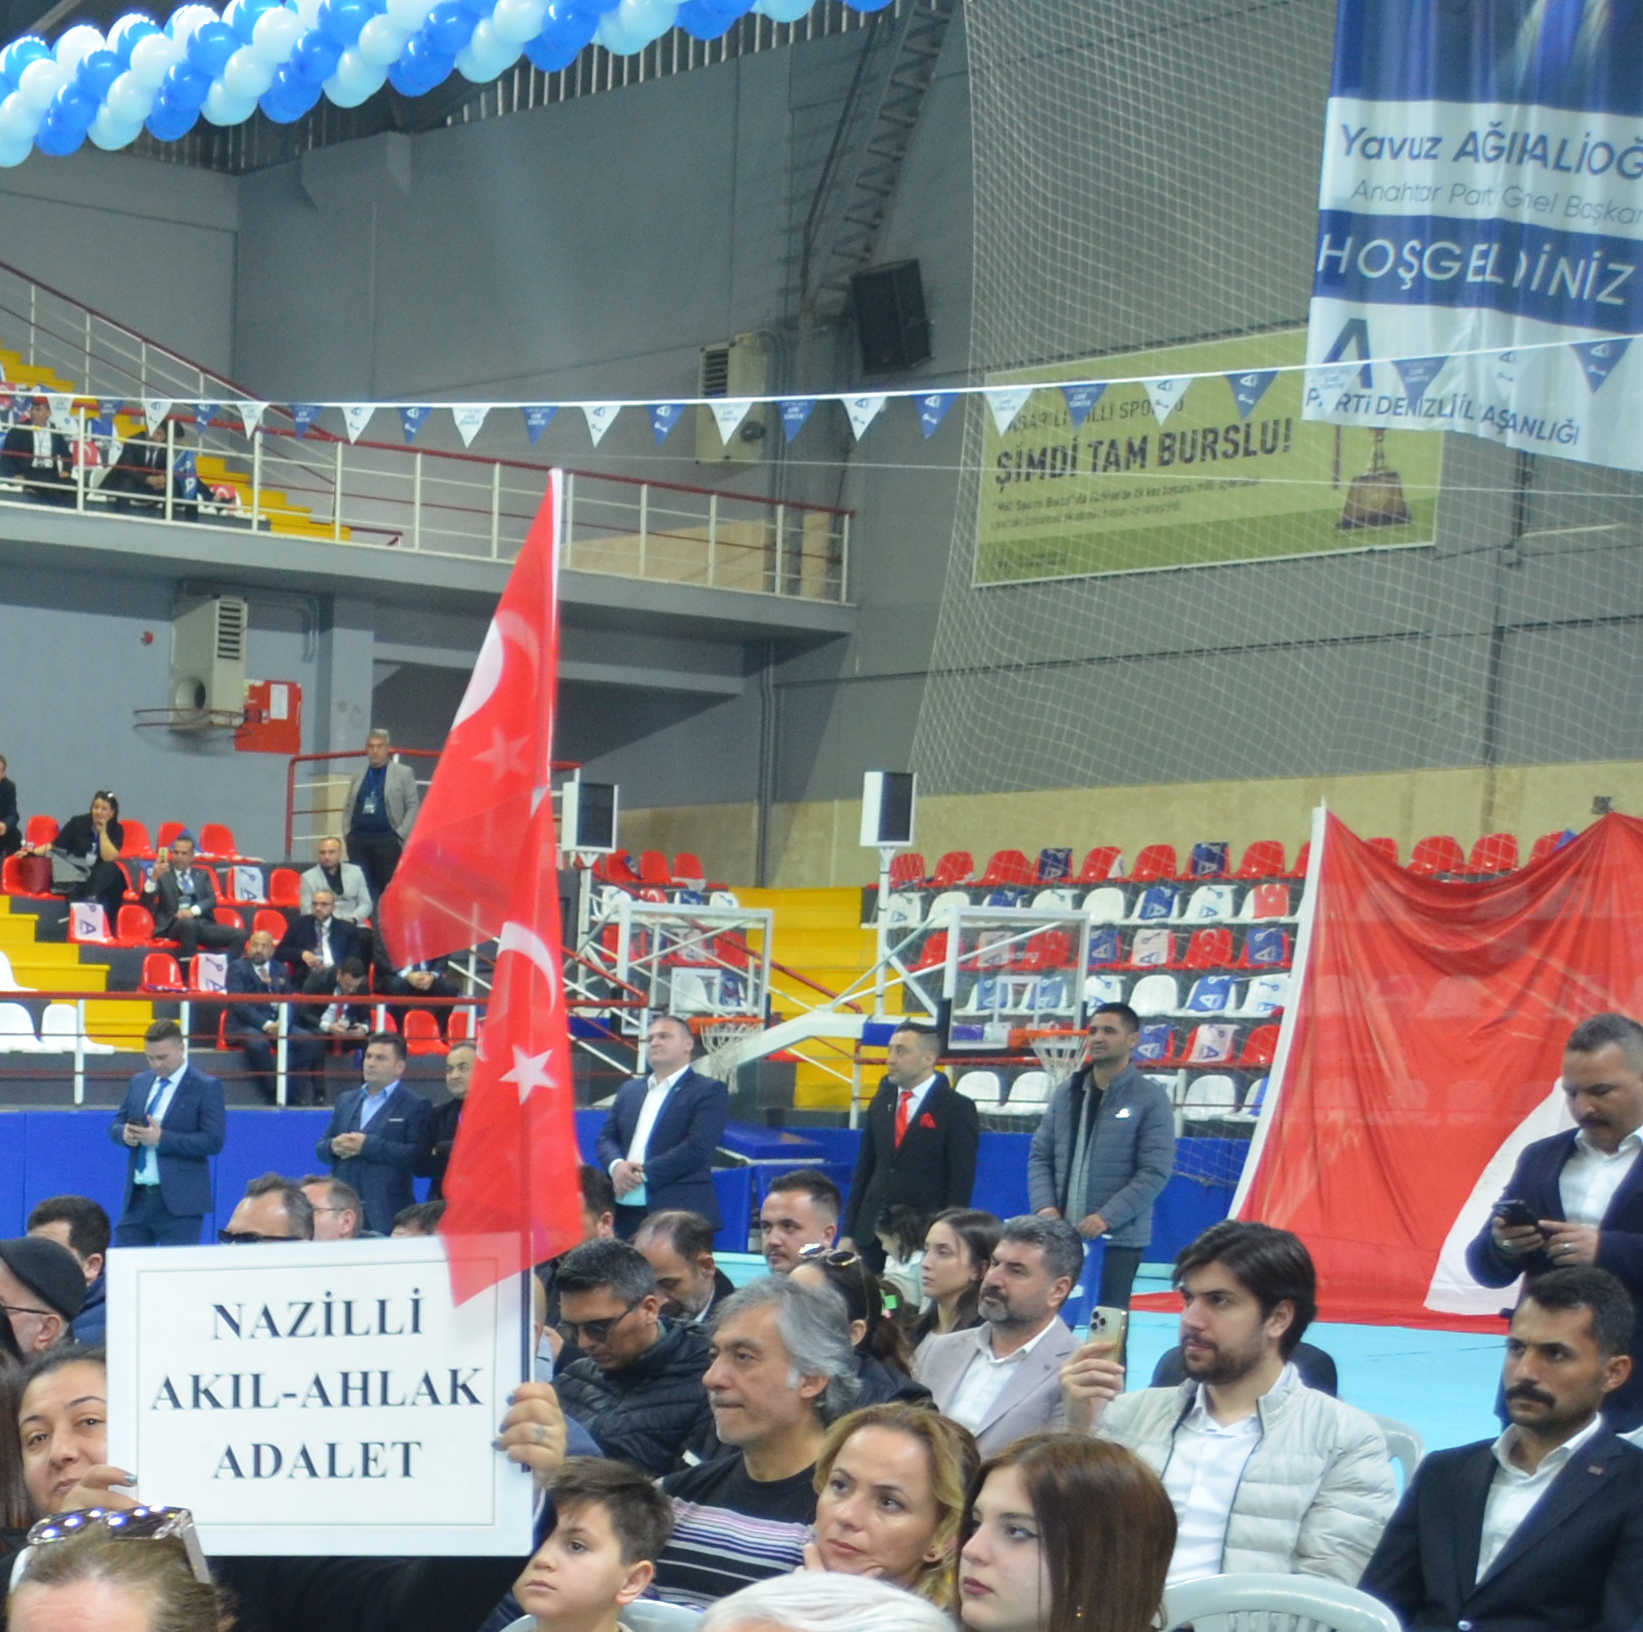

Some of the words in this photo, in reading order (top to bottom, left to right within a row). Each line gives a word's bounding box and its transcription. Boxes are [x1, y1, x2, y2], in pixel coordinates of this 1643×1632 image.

[1340, 123, 1443, 161] Yavuz
[1351, 180, 1443, 203] Anahtar
[1448, 182, 1499, 208] Part
[995, 435, 1079, 493] ŞİMDİ
[1088, 434, 1149, 474] TAM
[1158, 417, 1294, 468] BURSLU!
[210, 1286, 424, 1340] NAZİLLİ
[150, 1367, 484, 1412] AKIL-AHLAK
[213, 1440, 423, 1480] ADALET
